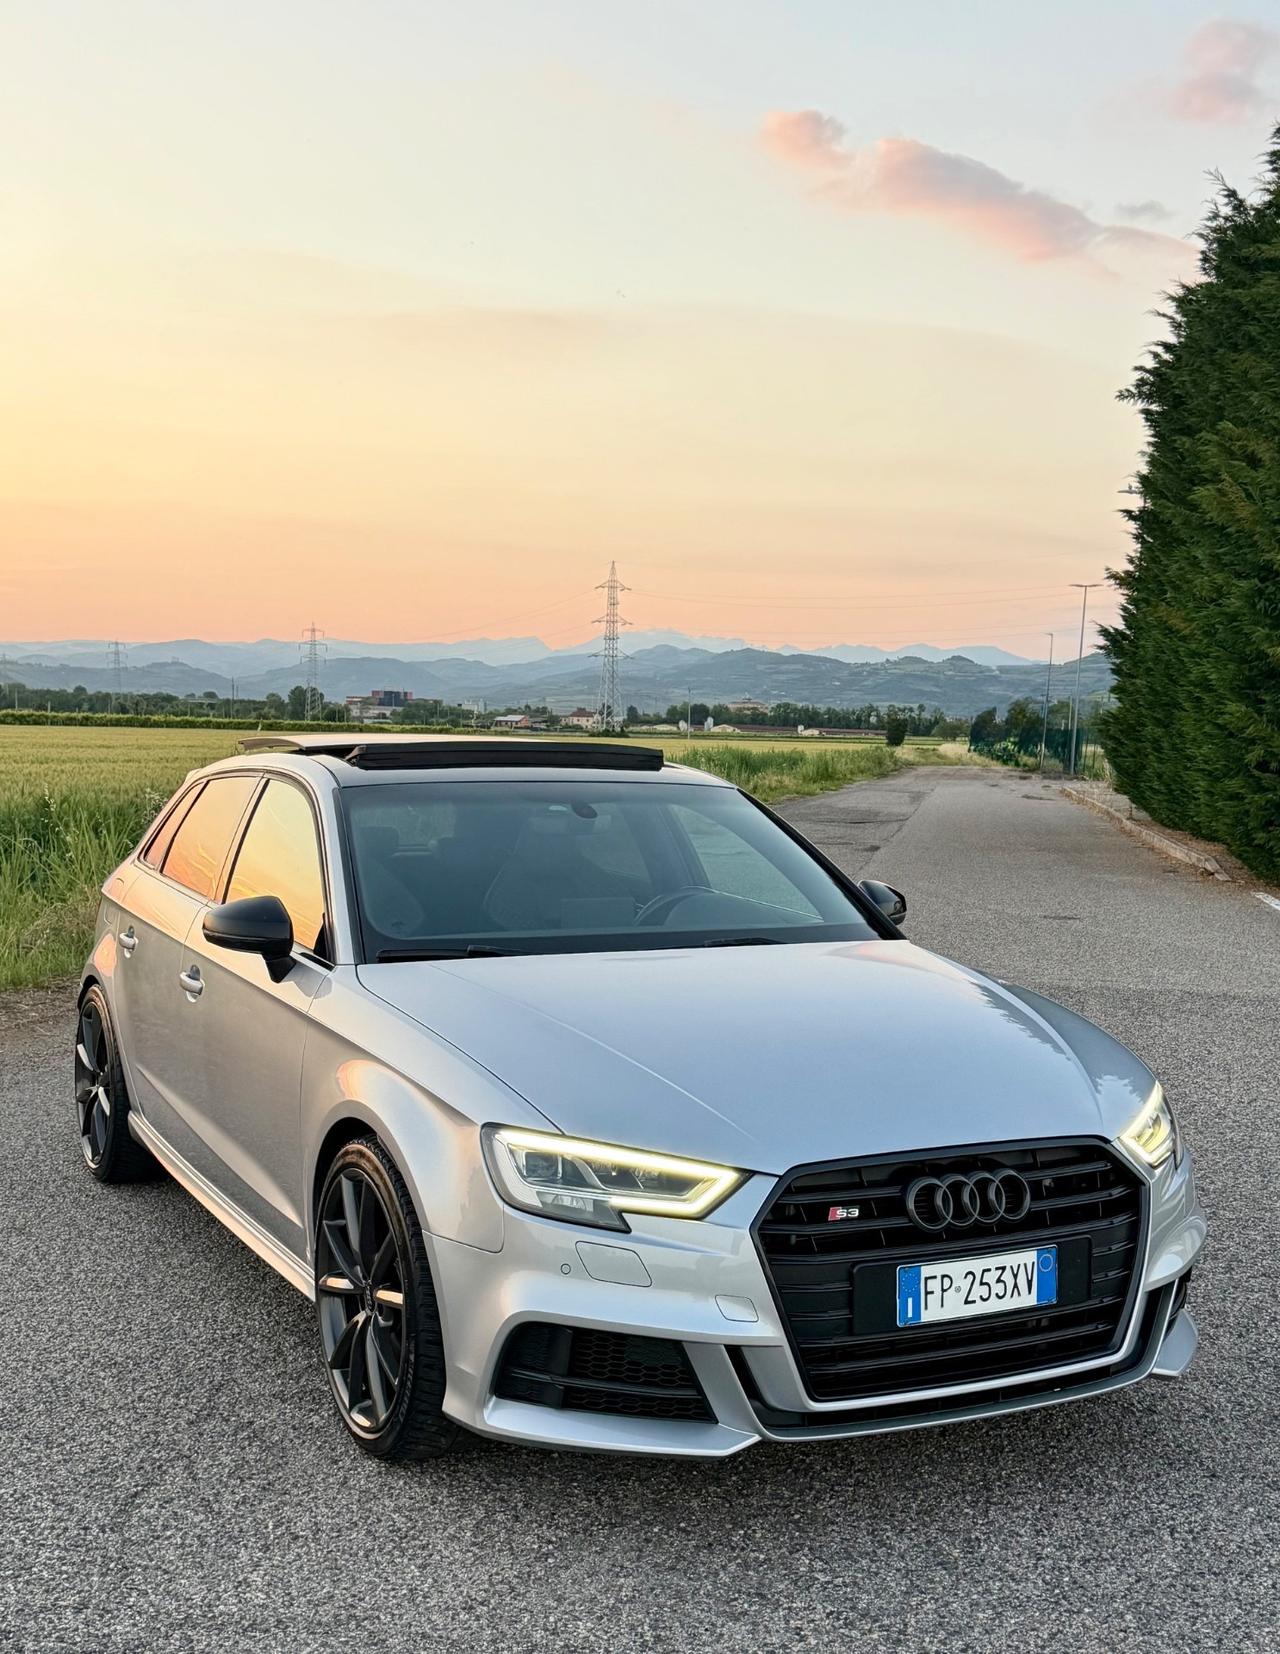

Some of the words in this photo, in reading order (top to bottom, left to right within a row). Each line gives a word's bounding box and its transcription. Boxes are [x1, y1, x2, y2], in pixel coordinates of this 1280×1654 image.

[835, 1208, 859, 1218] S3
[924, 1274, 954, 1311] FP
[963, 1261, 1035, 1305] 253XV
[907, 1297, 913, 1318] I
